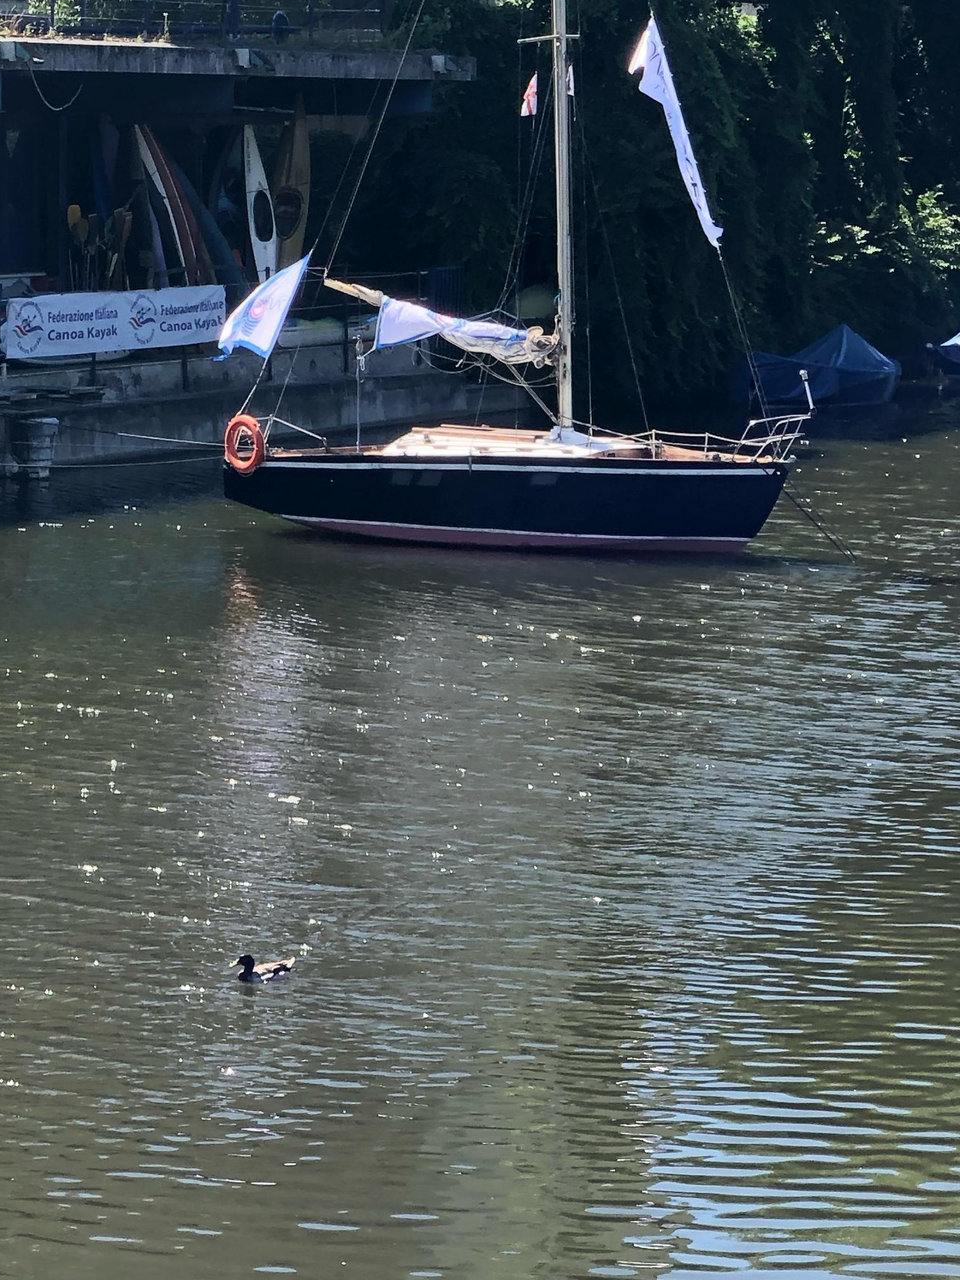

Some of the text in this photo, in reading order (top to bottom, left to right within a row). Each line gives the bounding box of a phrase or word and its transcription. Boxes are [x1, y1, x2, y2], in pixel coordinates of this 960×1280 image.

[47, 309, 94, 323] Federazione
[95, 308, 118, 320] Italiana
[47, 329, 84, 341] Canoa
[87, 324, 118, 340] Kayak
[159, 321, 192, 332] Canoa
